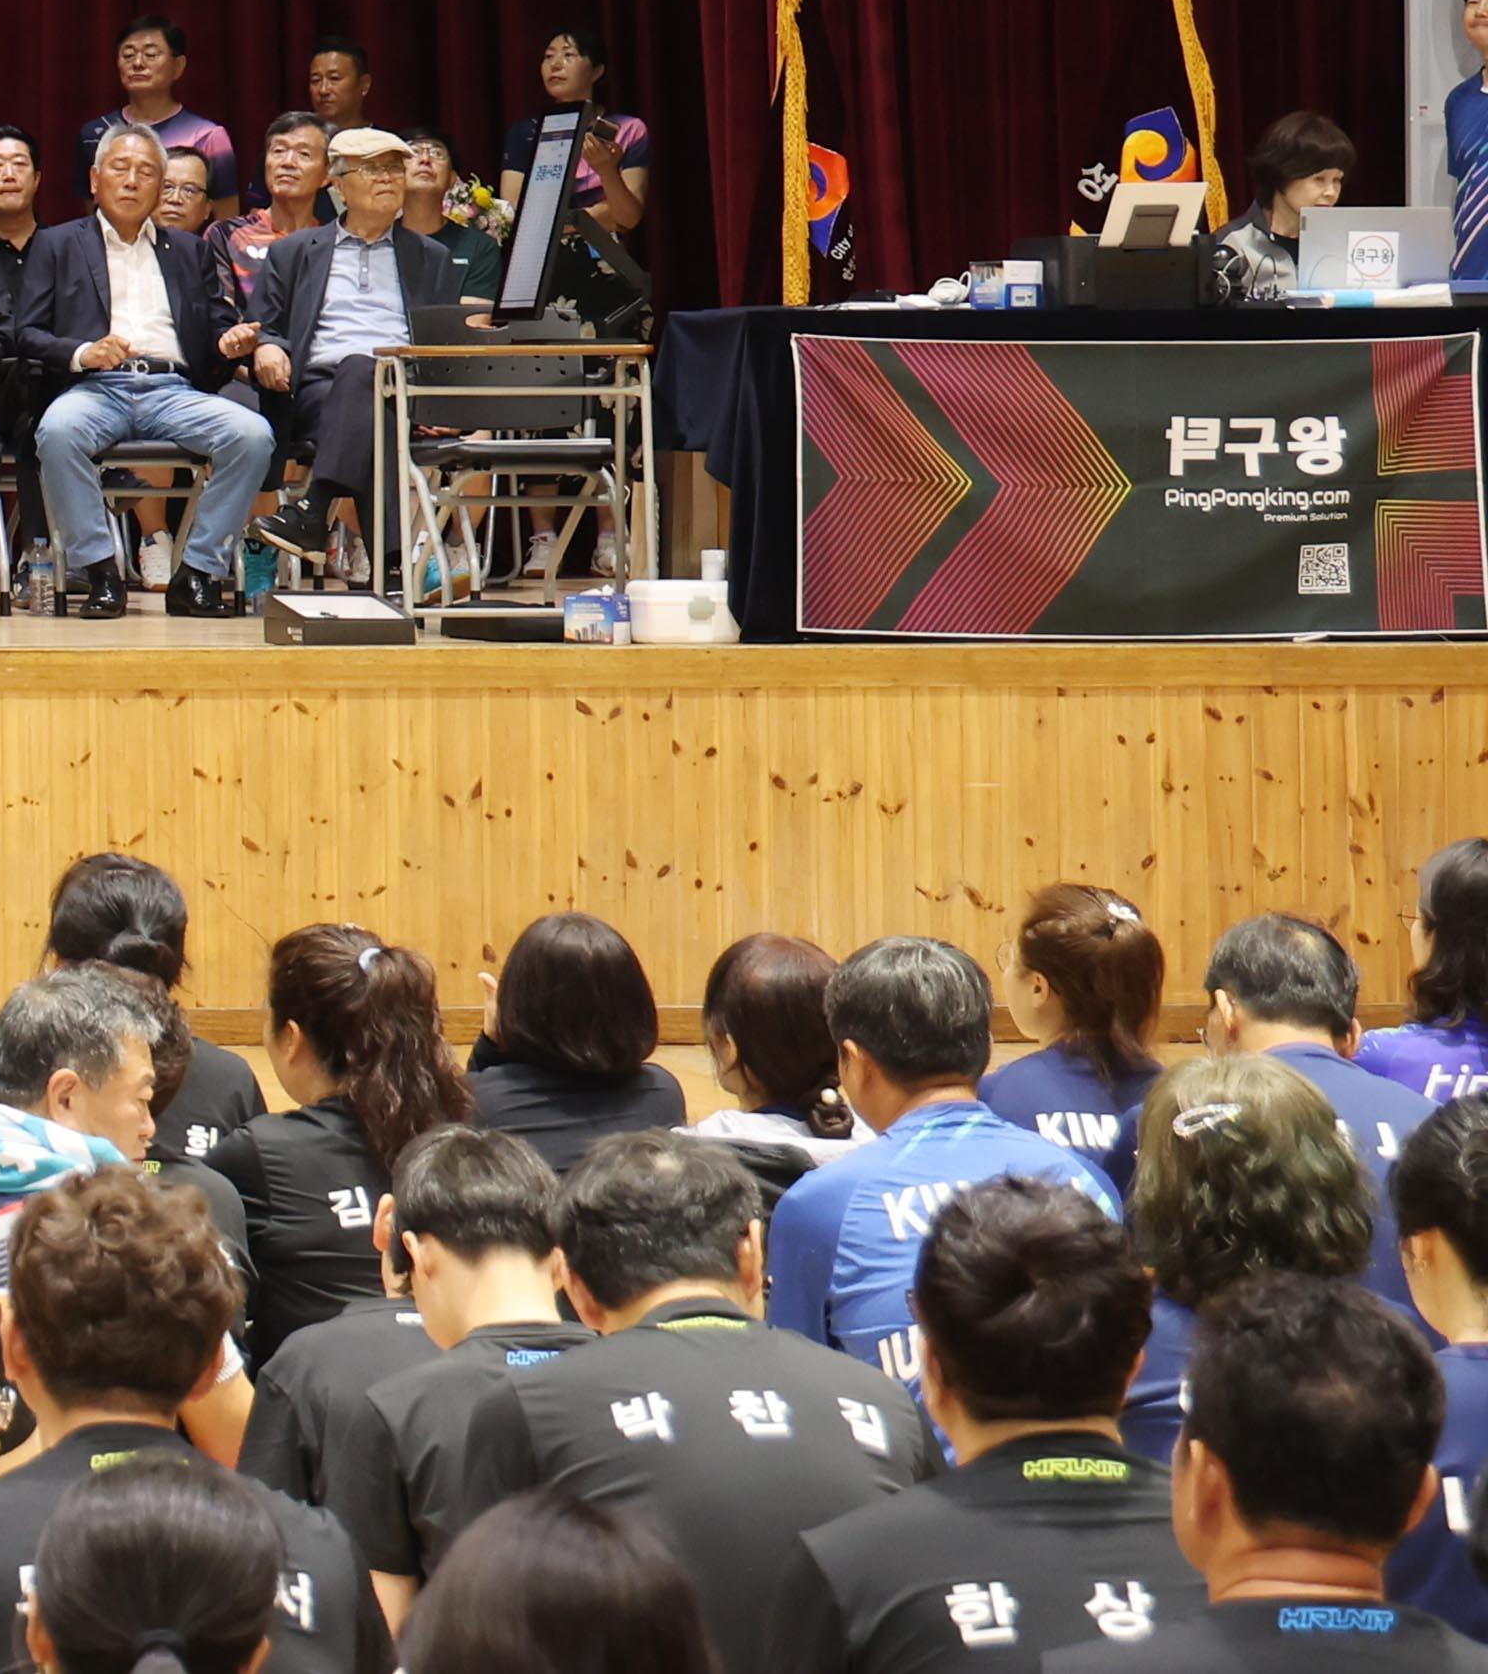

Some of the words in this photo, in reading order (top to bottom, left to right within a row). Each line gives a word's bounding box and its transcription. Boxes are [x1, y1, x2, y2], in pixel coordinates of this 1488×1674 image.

[1164, 486, 1351, 512] PingPongking.com
[1263, 513, 1308, 523] Premium
[1310, 511, 1348, 522] Solution
[611, 1390, 675, 1443] 박
[727, 1387, 793, 1440] 찬
[946, 1580, 1019, 1647] 한
[1085, 1580, 1158, 1642] 상
